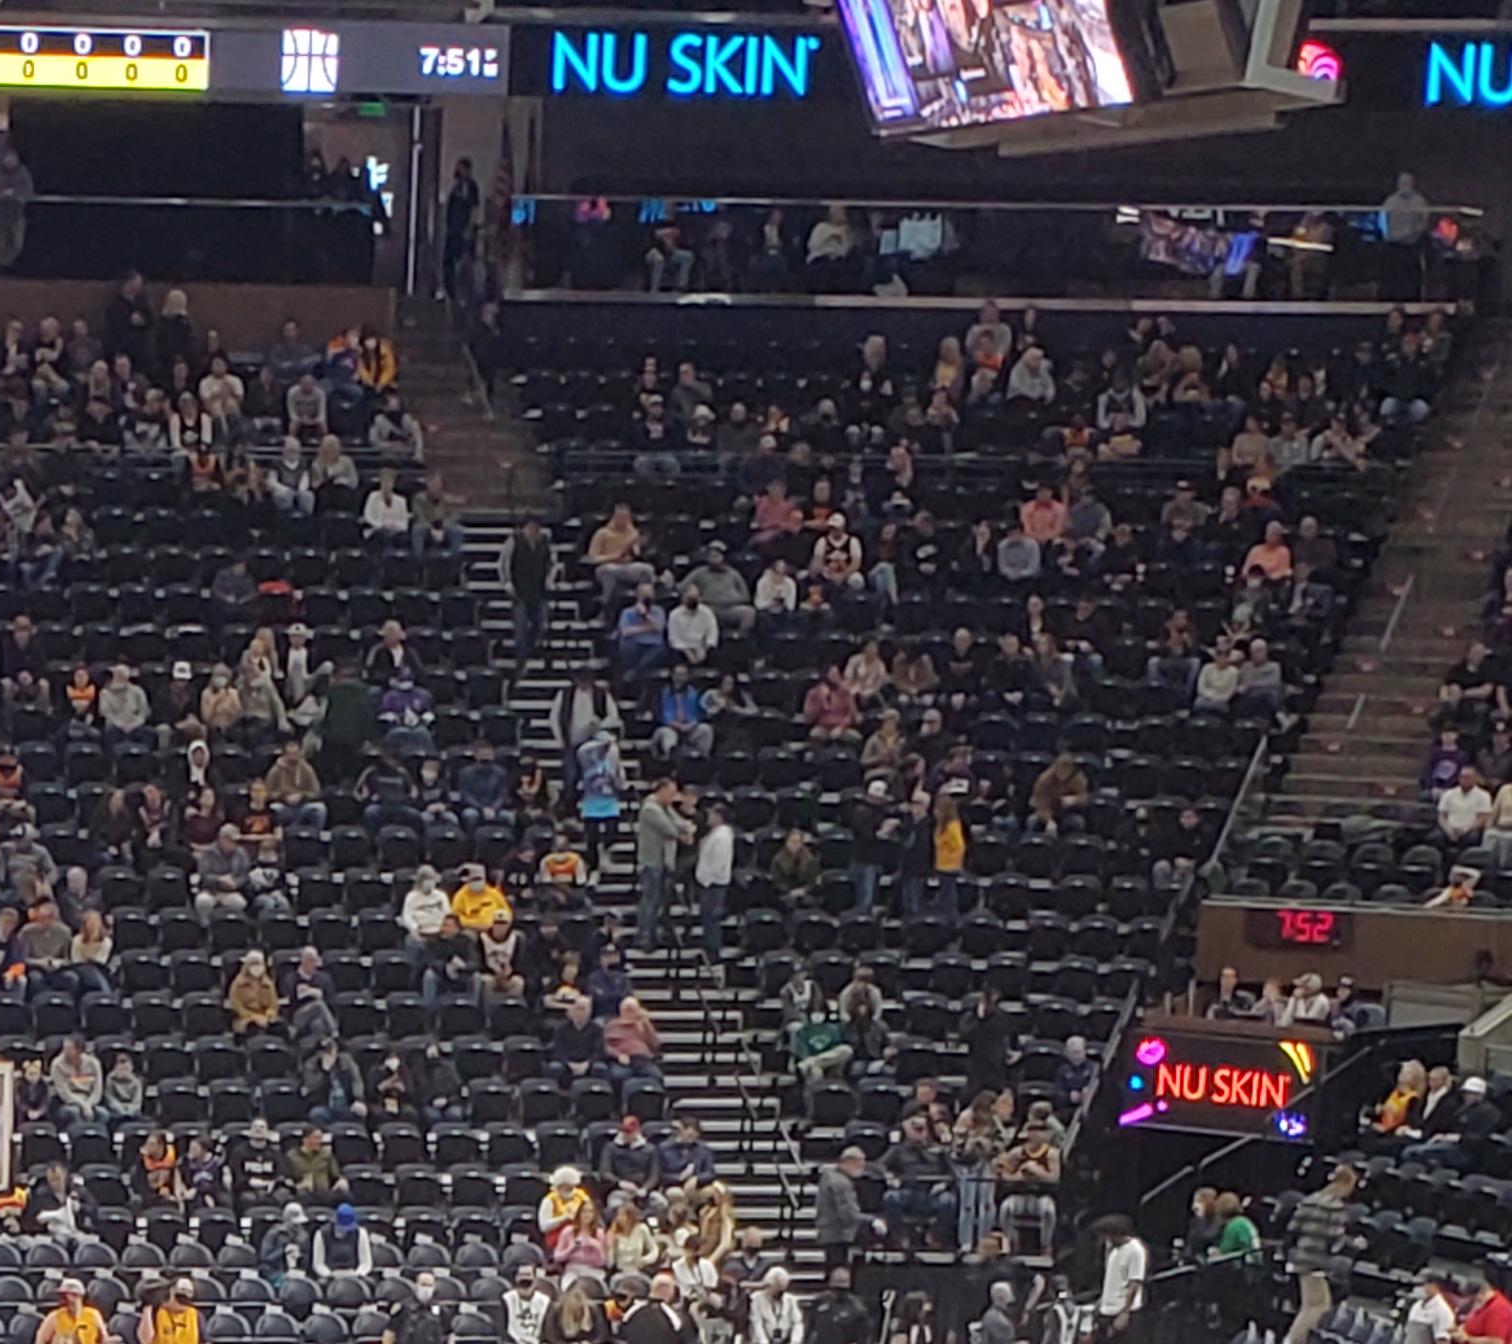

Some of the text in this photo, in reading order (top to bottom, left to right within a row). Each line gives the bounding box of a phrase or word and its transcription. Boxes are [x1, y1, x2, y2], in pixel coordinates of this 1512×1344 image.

[21, 32, 38, 53] 0
[74, 33, 92, 54] 0
[124, 34, 142, 56] 0
[174, 36, 191, 56] 0
[23, 60, 35, 78] 0
[76, 61, 88, 79] 0
[126, 63, 138, 81] 0
[175, 64, 187, 82] 0
[553, 31, 648, 94] NU
[667, 34, 806, 96] SKIN
[1156, 1063, 1286, 1109] NU SKIN
